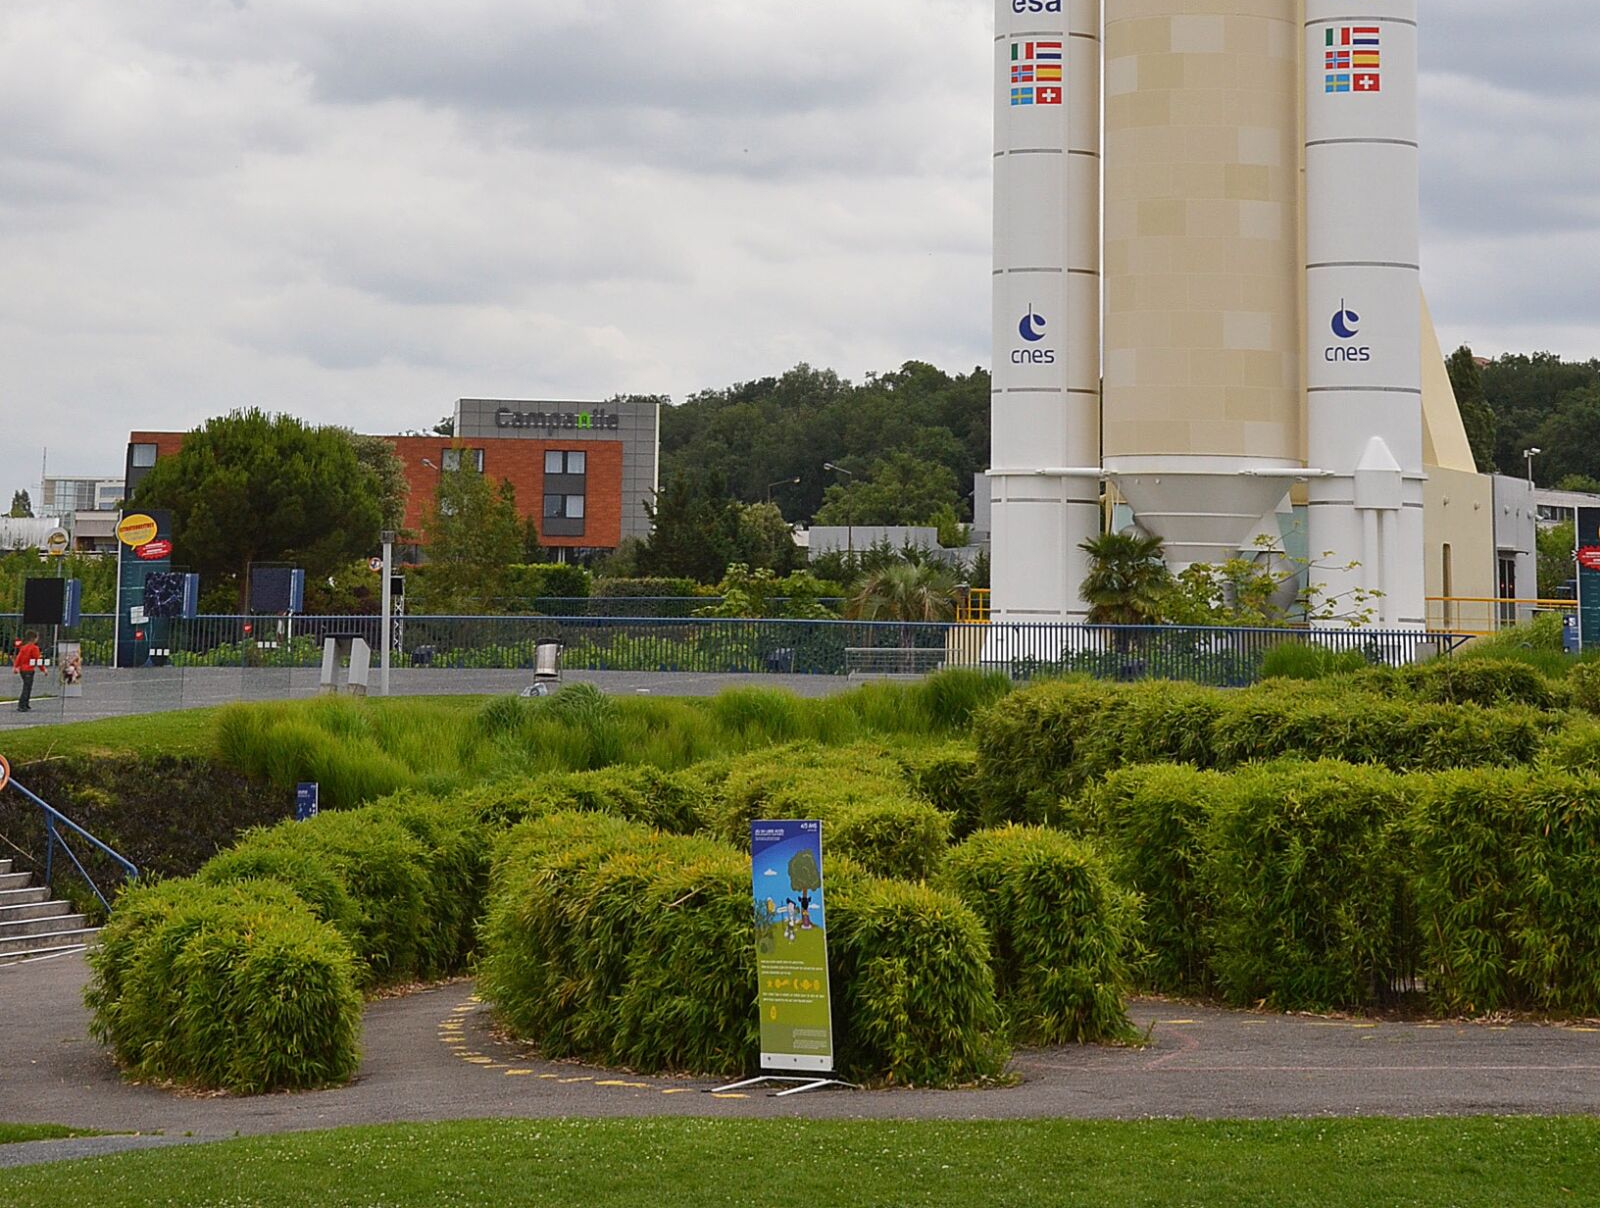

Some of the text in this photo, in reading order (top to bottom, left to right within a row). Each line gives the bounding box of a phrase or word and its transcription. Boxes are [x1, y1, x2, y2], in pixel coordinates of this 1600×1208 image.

[1011, 349, 1055, 364] cnes
[1325, 346, 1370, 362] cnes
[496, 407, 619, 436] Campanile
